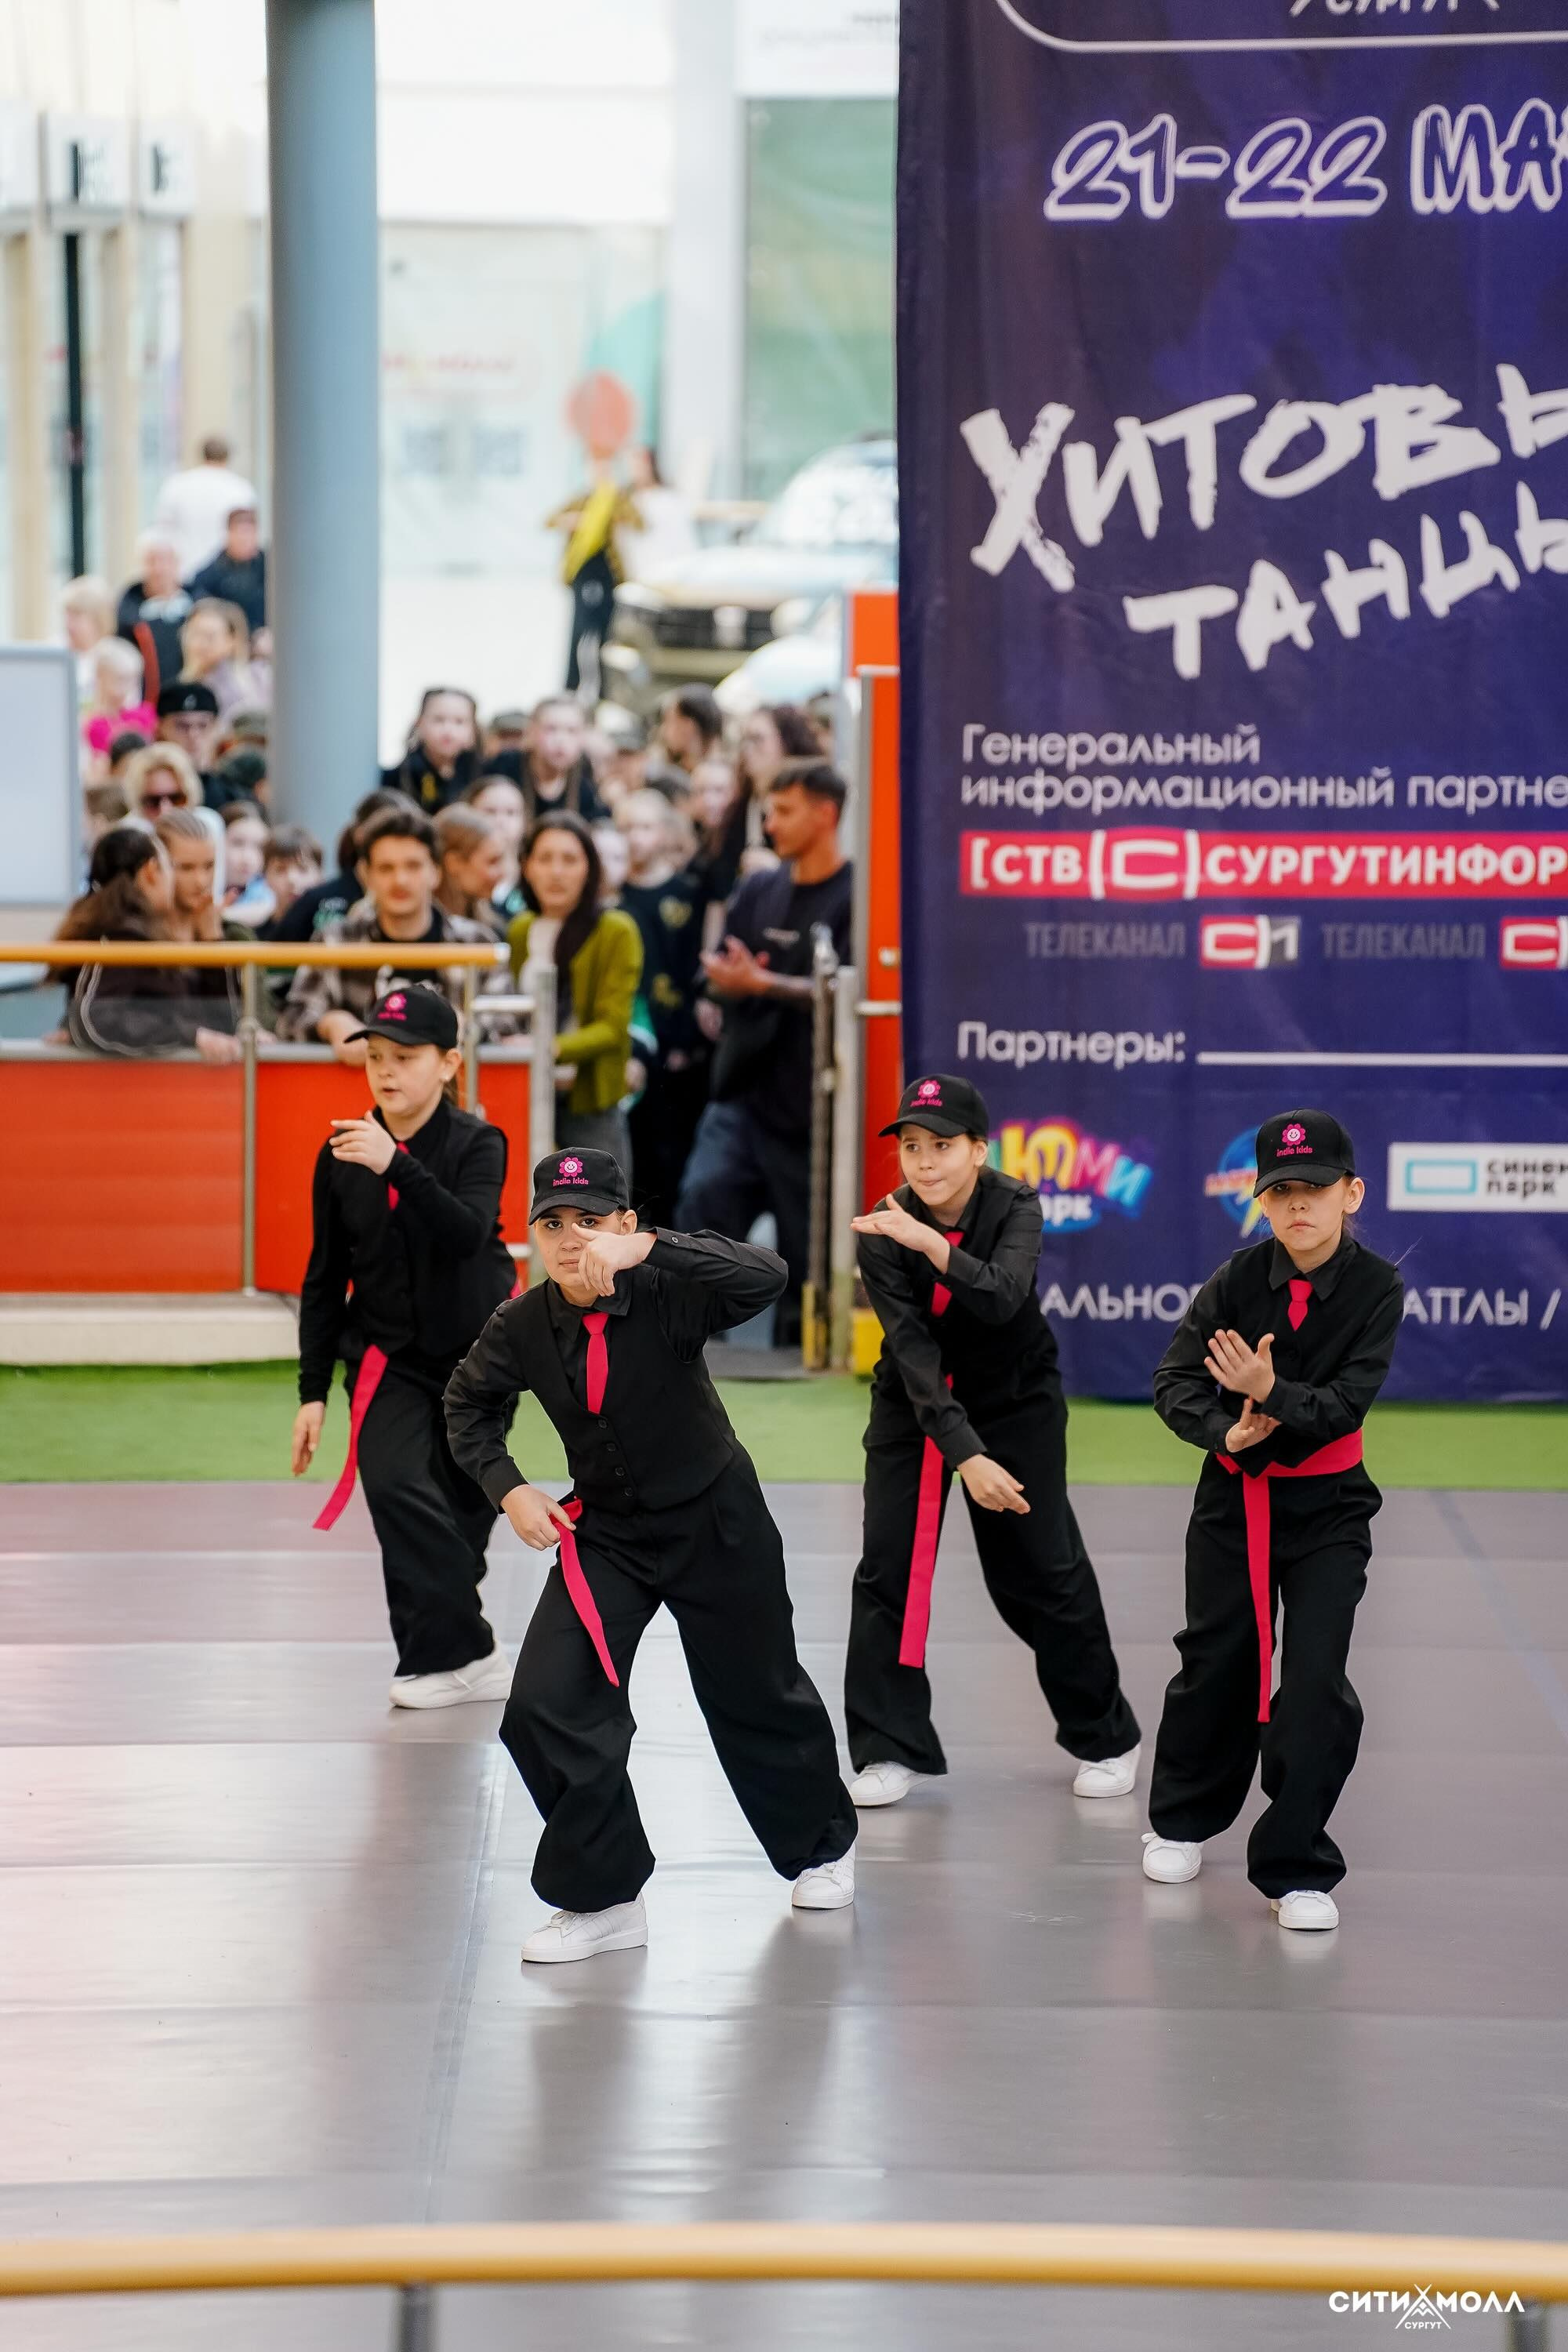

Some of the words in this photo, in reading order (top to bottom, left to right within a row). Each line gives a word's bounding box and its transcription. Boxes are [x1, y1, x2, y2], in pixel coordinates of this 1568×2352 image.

[1044, 114, 1387, 220] 21-22
[1410, 97, 1568, 215] МА
[962, 724, 1260, 771] Генеральный
[961, 766, 1394, 816] информационный
[1025, 922, 1186, 958] ТЕЛЕКАНАЛ
[1323, 923, 1485, 959] ТЕЛЕКАНАЛ
[957, 1021, 1186, 1070] Партнеры:
[1276, 1147, 1294, 1156] indie
[1296, 1145, 1312, 1155] kids
[553, 1178, 571, 1186] indie
[1402, 1287, 1529, 1326] АТТЛЫ
